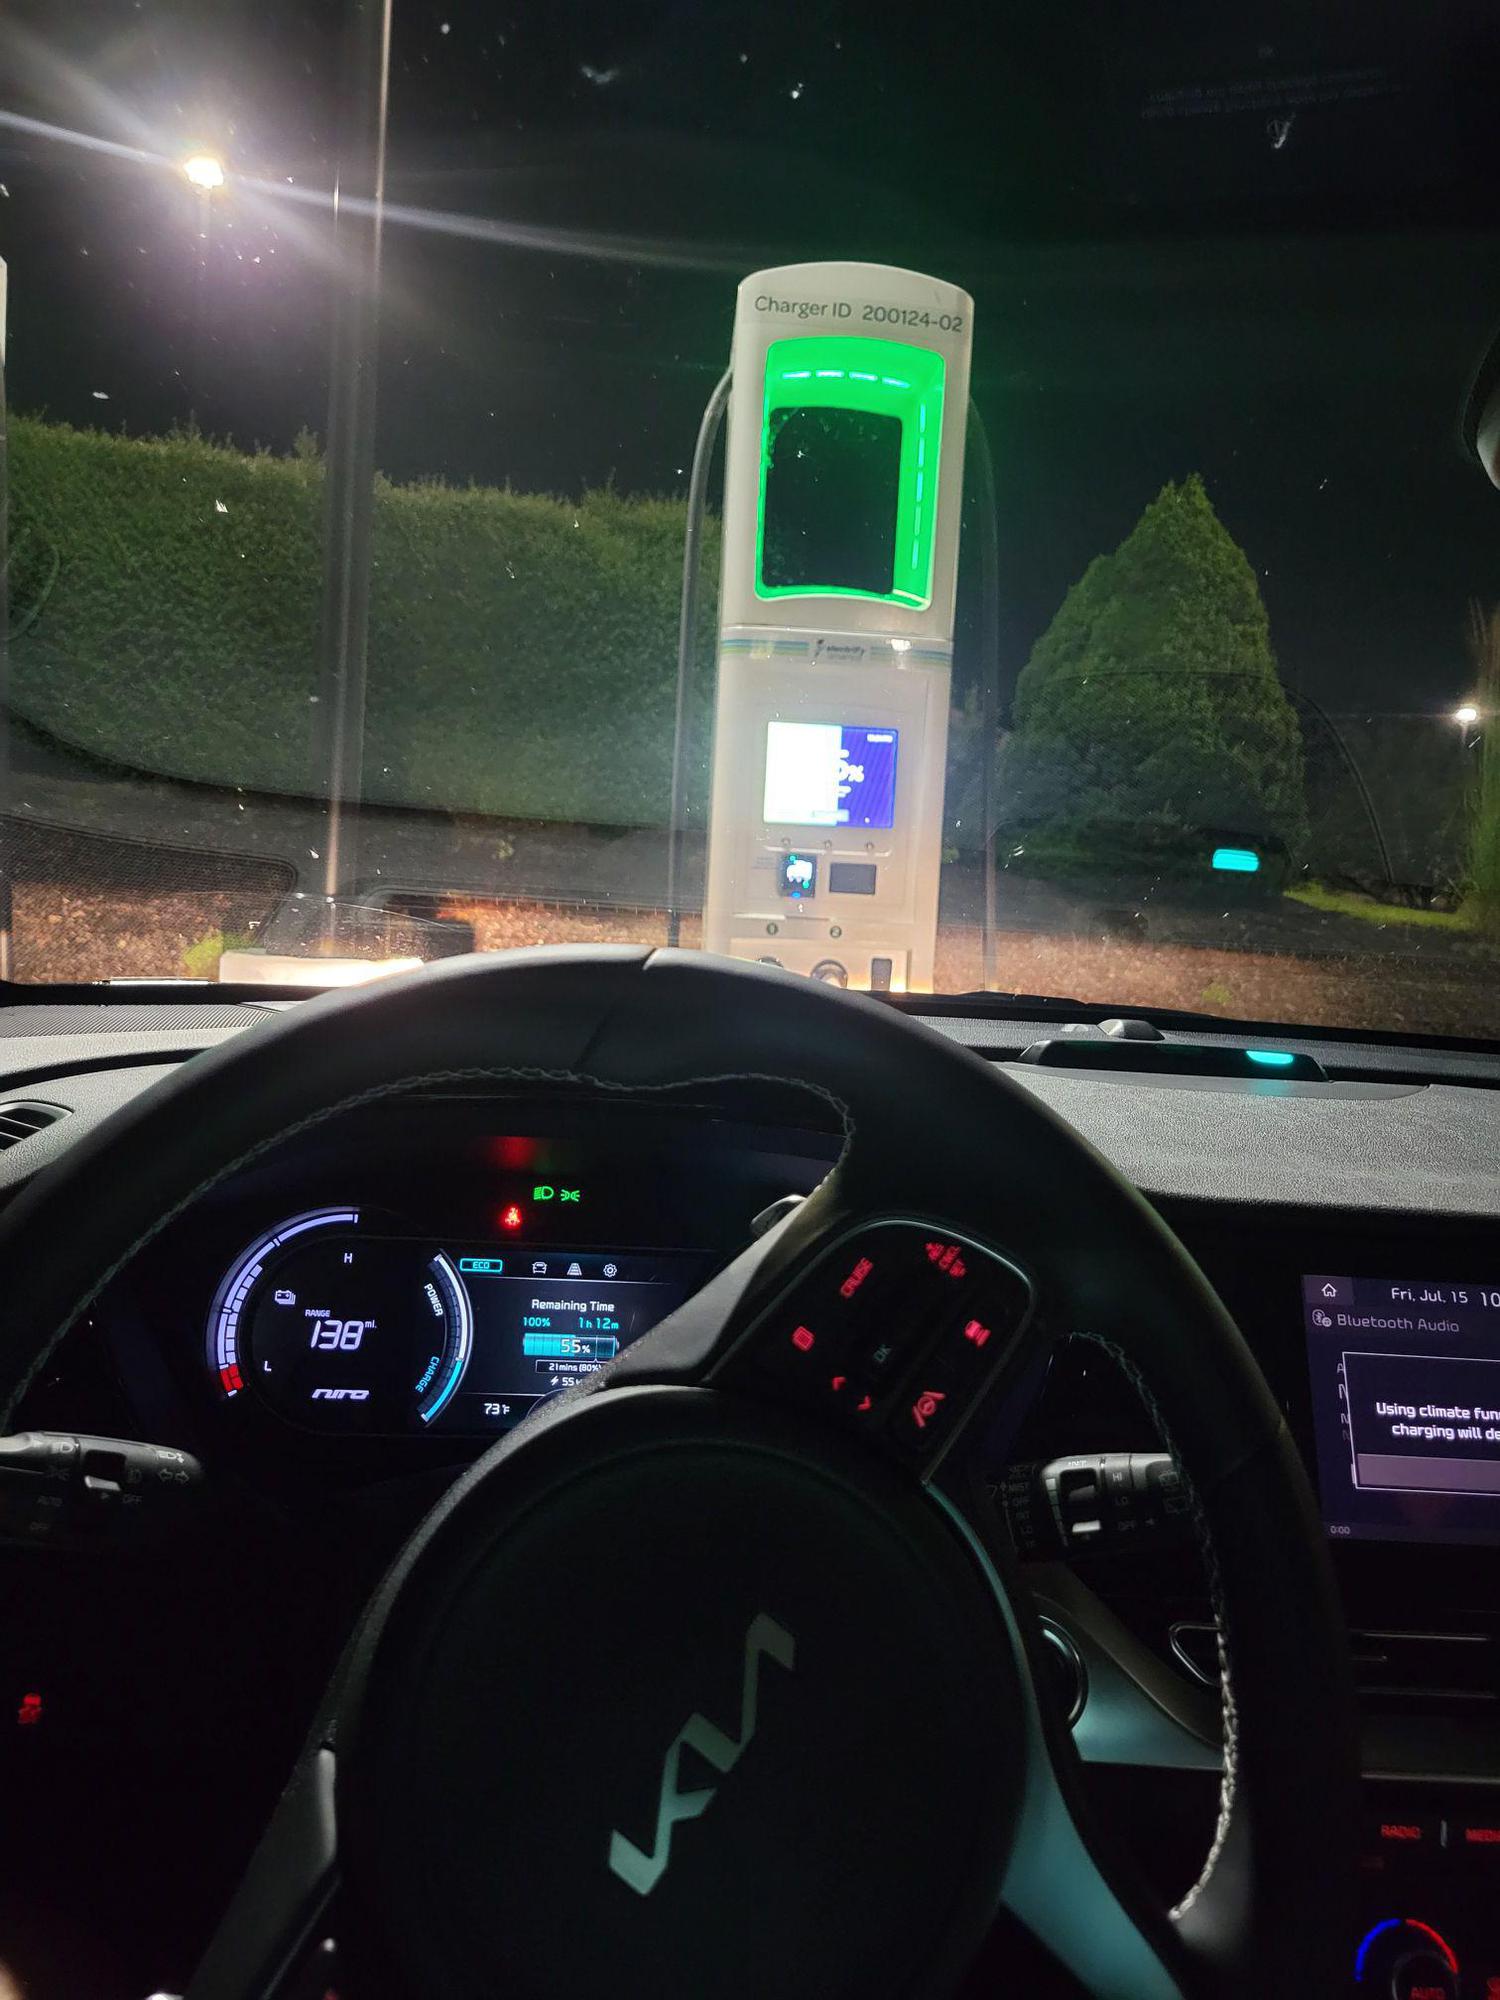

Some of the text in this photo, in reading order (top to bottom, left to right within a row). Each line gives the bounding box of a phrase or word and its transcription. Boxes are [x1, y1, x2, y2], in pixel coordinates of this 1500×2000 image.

[754, 295, 963, 333] Charger ID 200124-02
[344, 1253, 353, 1263] H
[473, 1261, 490, 1269] ECO
[424, 1283, 444, 1317] POWER
[1451, 1290, 1468, 1303] 15
[531, 1299, 615, 1312] Remaining Time
[305, 1309, 331, 1317] RANGE
[523, 1317, 551, 1327] 100%
[1337, 1313, 1460, 1332] Bluetooth Audio
[310, 1319, 364, 1350] 138
[264, 1360, 272, 1372] L
[415, 1356, 440, 1393] CHARGE
[1376, 1402, 1500, 1421] Using climate fun
[1391, 1423, 1455, 1440] charging
[1457, 1426, 1483, 1439] will
[1330, 1525, 1351, 1535] 0:00
[1381, 1824, 1421, 1840] RADIO
